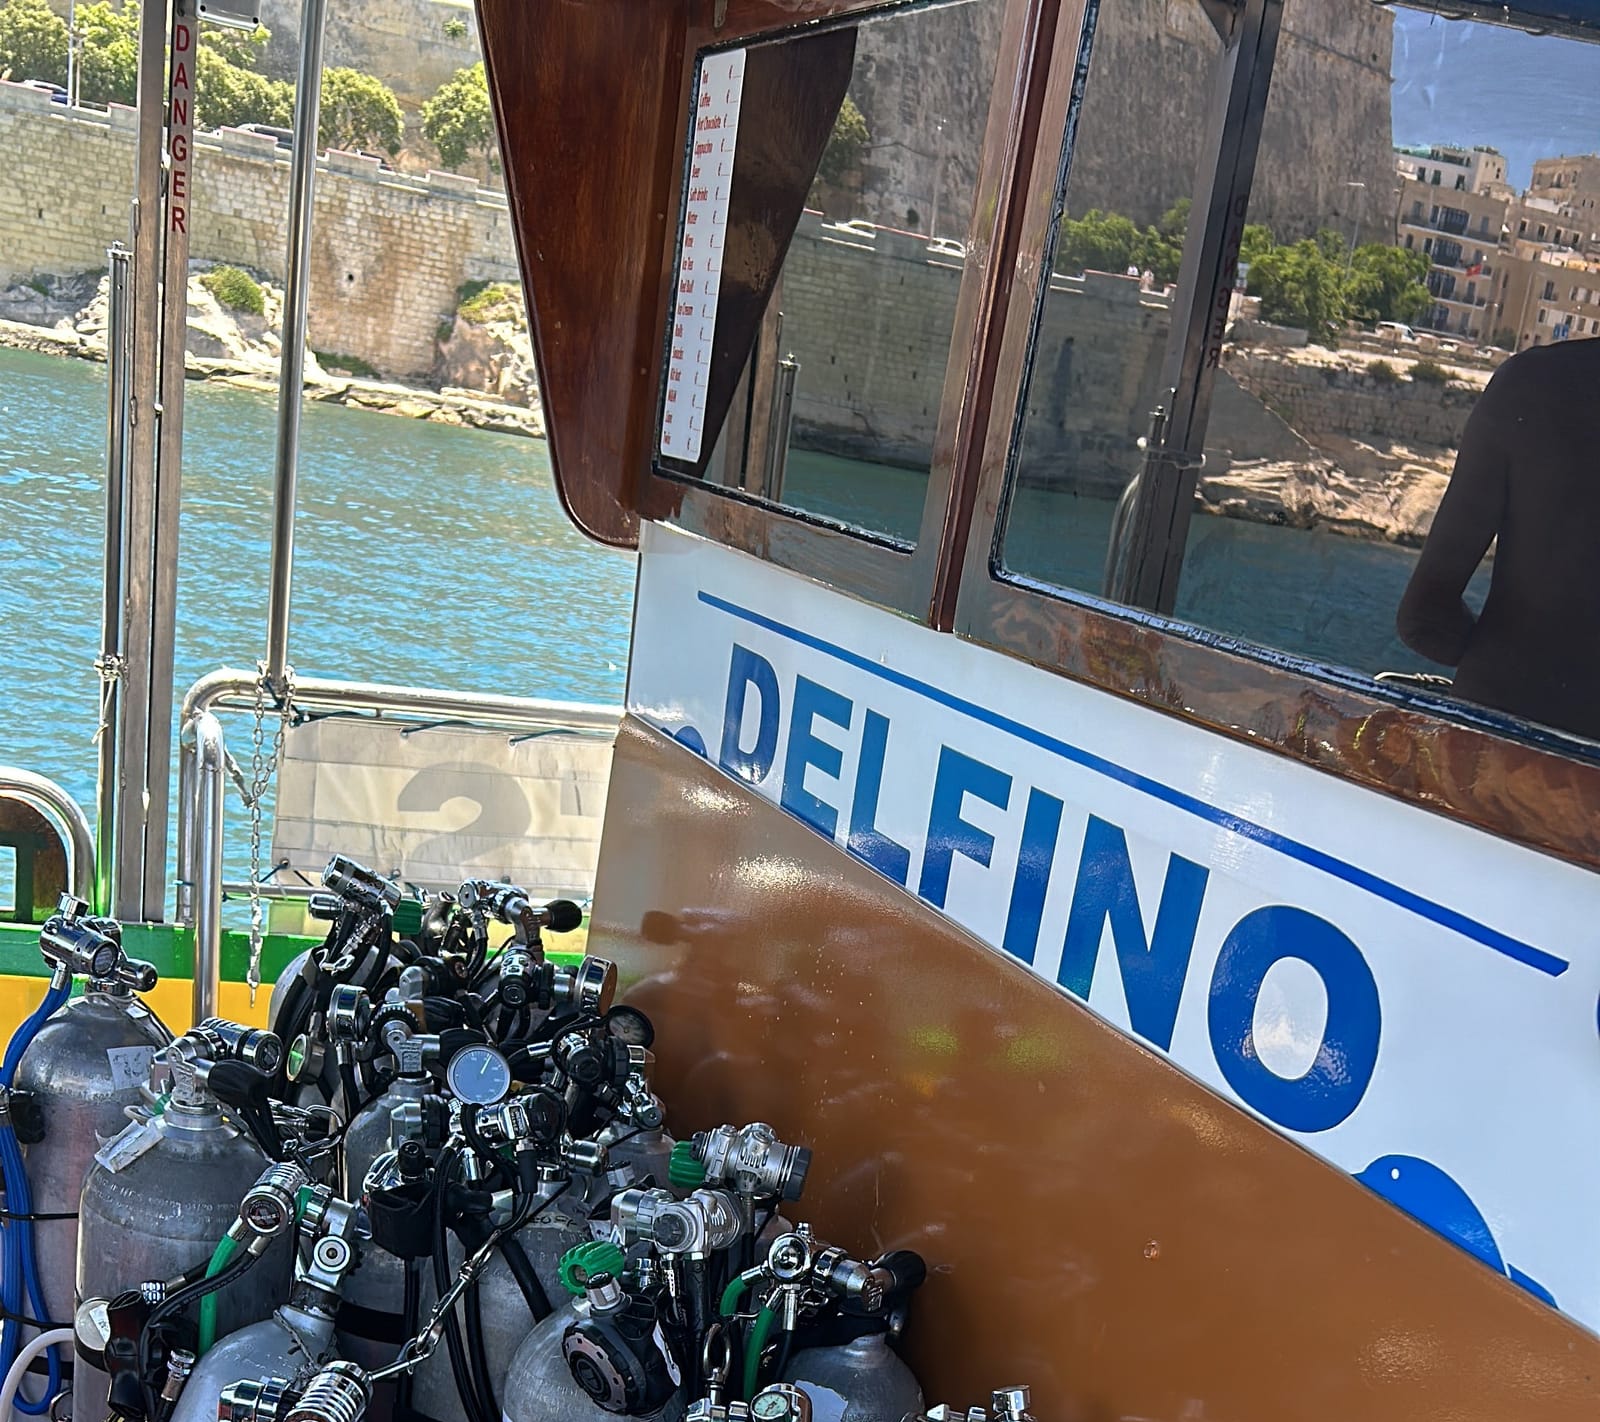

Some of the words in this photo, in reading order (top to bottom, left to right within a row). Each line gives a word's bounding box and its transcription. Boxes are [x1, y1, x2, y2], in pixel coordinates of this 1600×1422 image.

[171, 25, 190, 233] DANGER
[699, 93, 711, 107] Coffee
[689, 187, 697, 201] Soft
[719, 643, 1381, 1133] DELFINO
